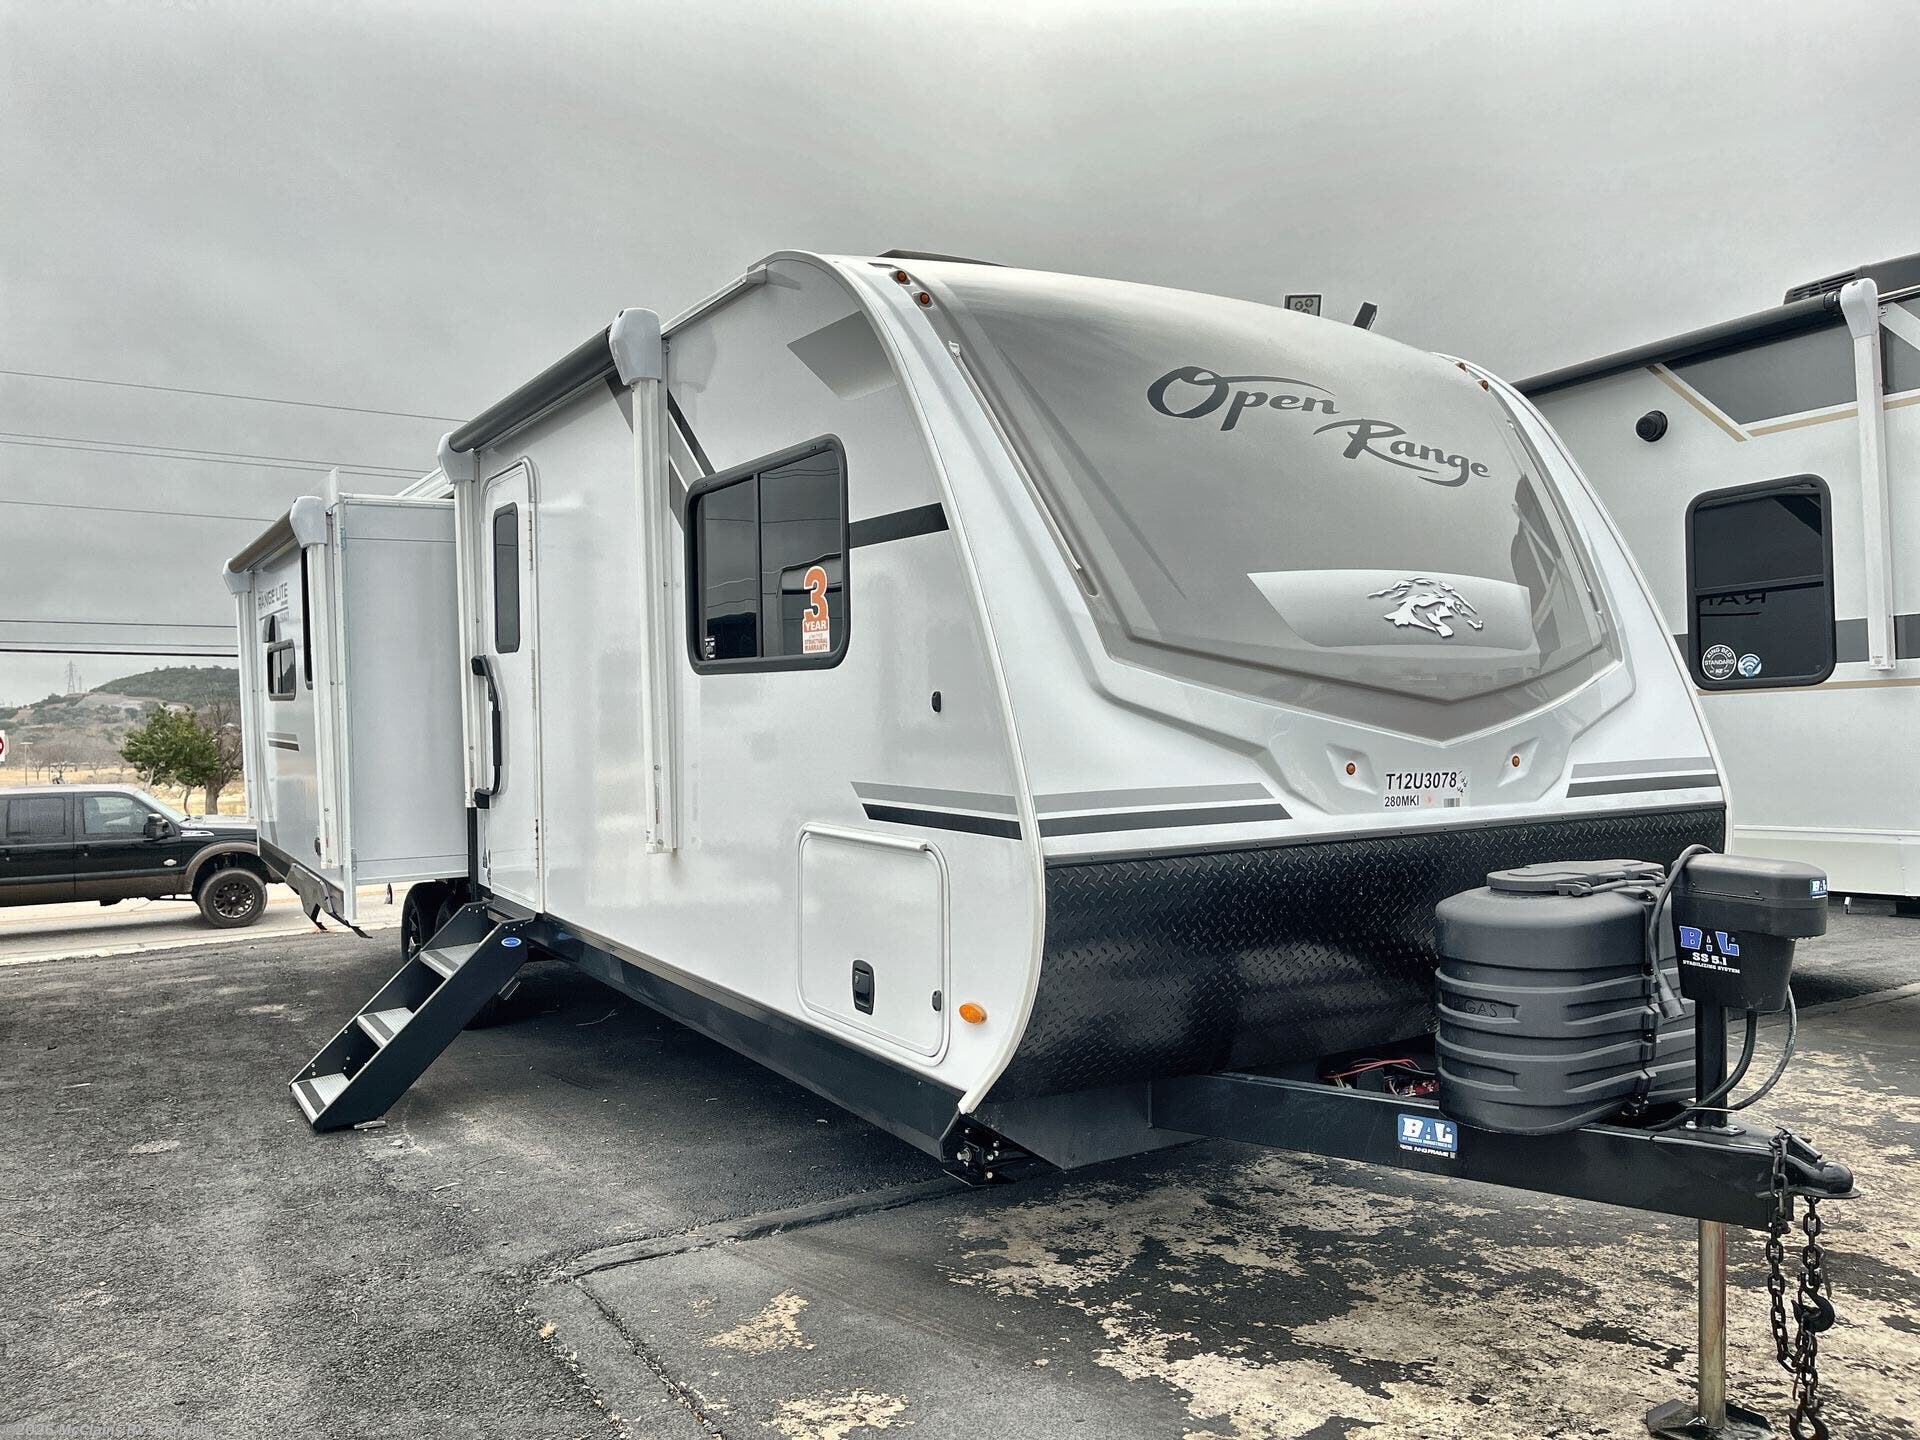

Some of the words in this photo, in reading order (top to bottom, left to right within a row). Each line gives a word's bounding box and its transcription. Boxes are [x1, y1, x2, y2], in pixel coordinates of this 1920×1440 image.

[1147, 366, 1340, 431] Open
[1313, 419, 1490, 487] Range
[257, 588, 275, 611] RANGE
[275, 582, 288, 602] LITE
[804, 566, 828, 620] 3
[804, 620, 827, 631] YEAR
[1707, 647, 1721, 659] KING
[1721, 647, 1733, 658] BED
[1385, 771, 1457, 790] T12U3078
[1679, 925, 1740, 956] BAL
[1692, 951, 1709, 963] SS
[1711, 955, 1727, 966] 5.1
[1717, 965, 1740, 974] SYSTEM
[1464, 1000, 1498, 1018] GAS
[1402, 1117, 1453, 1144] BAL
